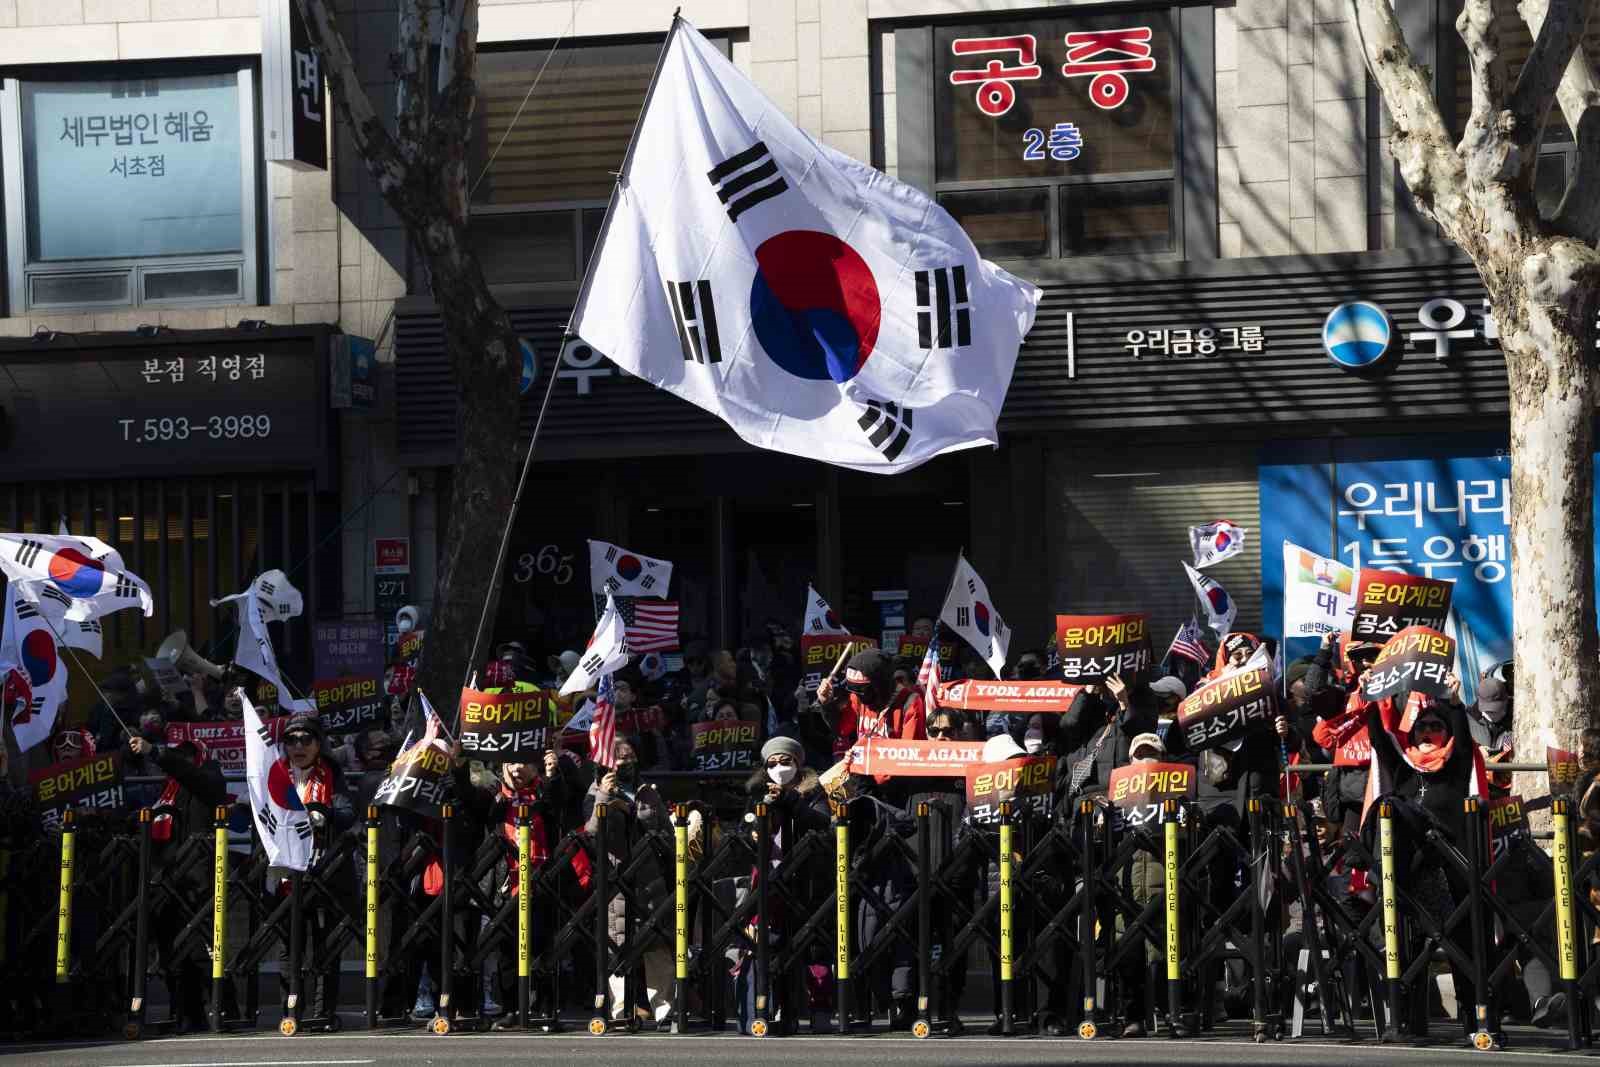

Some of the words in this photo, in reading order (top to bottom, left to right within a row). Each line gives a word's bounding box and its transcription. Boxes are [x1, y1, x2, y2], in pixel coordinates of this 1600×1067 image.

[59, 113, 159, 148] 세무법인
[164, 110, 214, 143] 혜움
[1023, 122, 1084, 161] 2층
[109, 154, 165, 178] 서초점
[1125, 325, 1265, 359] 우리금융그룹
[141, 357, 183, 383] 본점
[196, 354, 265, 382] 직영점
[118, 415, 271, 443] T.593-3989
[1339, 479, 1511, 530] 우리나라
[513, 545, 575, 586] 365
[376, 581, 408, 596] 271
[1364, 582, 1445, 607] 윤어게인
[1064, 620, 1143, 648] 윤어게인
[1063, 649, 1147, 678] 공소기각!
[465, 697, 542, 724] 윤어게인
[1184, 670, 1262, 716] 윤어게인
[1187, 695, 1273, 747] 공소기각!
[876, 746, 924, 762] YOON,
[928, 747, 978, 762] AGAIN
[38, 757, 114, 801] 윤어게인
[973, 762, 1051, 797] 윤어게인
[1113, 770, 1189, 801] 윤어게인
[214, 855, 224, 912] POLICE
[519, 854, 528, 911] POLICE
[838, 855, 847, 912] POLICE
[1167, 851, 1176, 911] POLICE
[1557, 844, 1570, 907] POLICE
[214, 924, 223, 962] LINE
[519, 922, 528, 960] LINE
[839, 924, 848, 962] LINE
[1169, 924, 1178, 962] LINE
[1563, 920, 1573, 962] LINE
